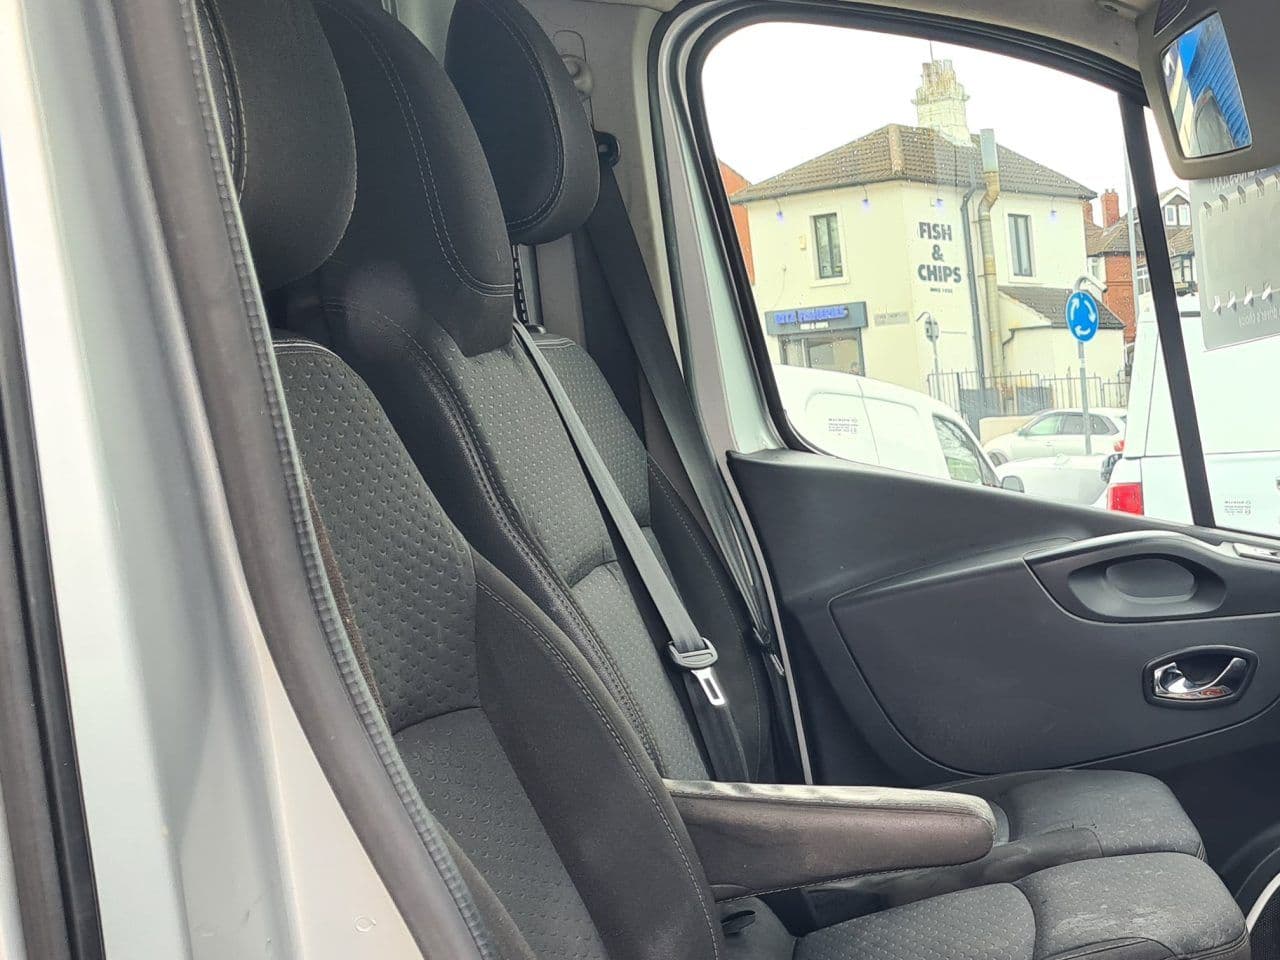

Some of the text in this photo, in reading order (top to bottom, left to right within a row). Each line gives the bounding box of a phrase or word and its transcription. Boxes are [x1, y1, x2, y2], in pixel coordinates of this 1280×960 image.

[918, 221, 952, 241] FISH
[931, 244, 944, 262] &
[918, 264, 962, 283] CHIPS
